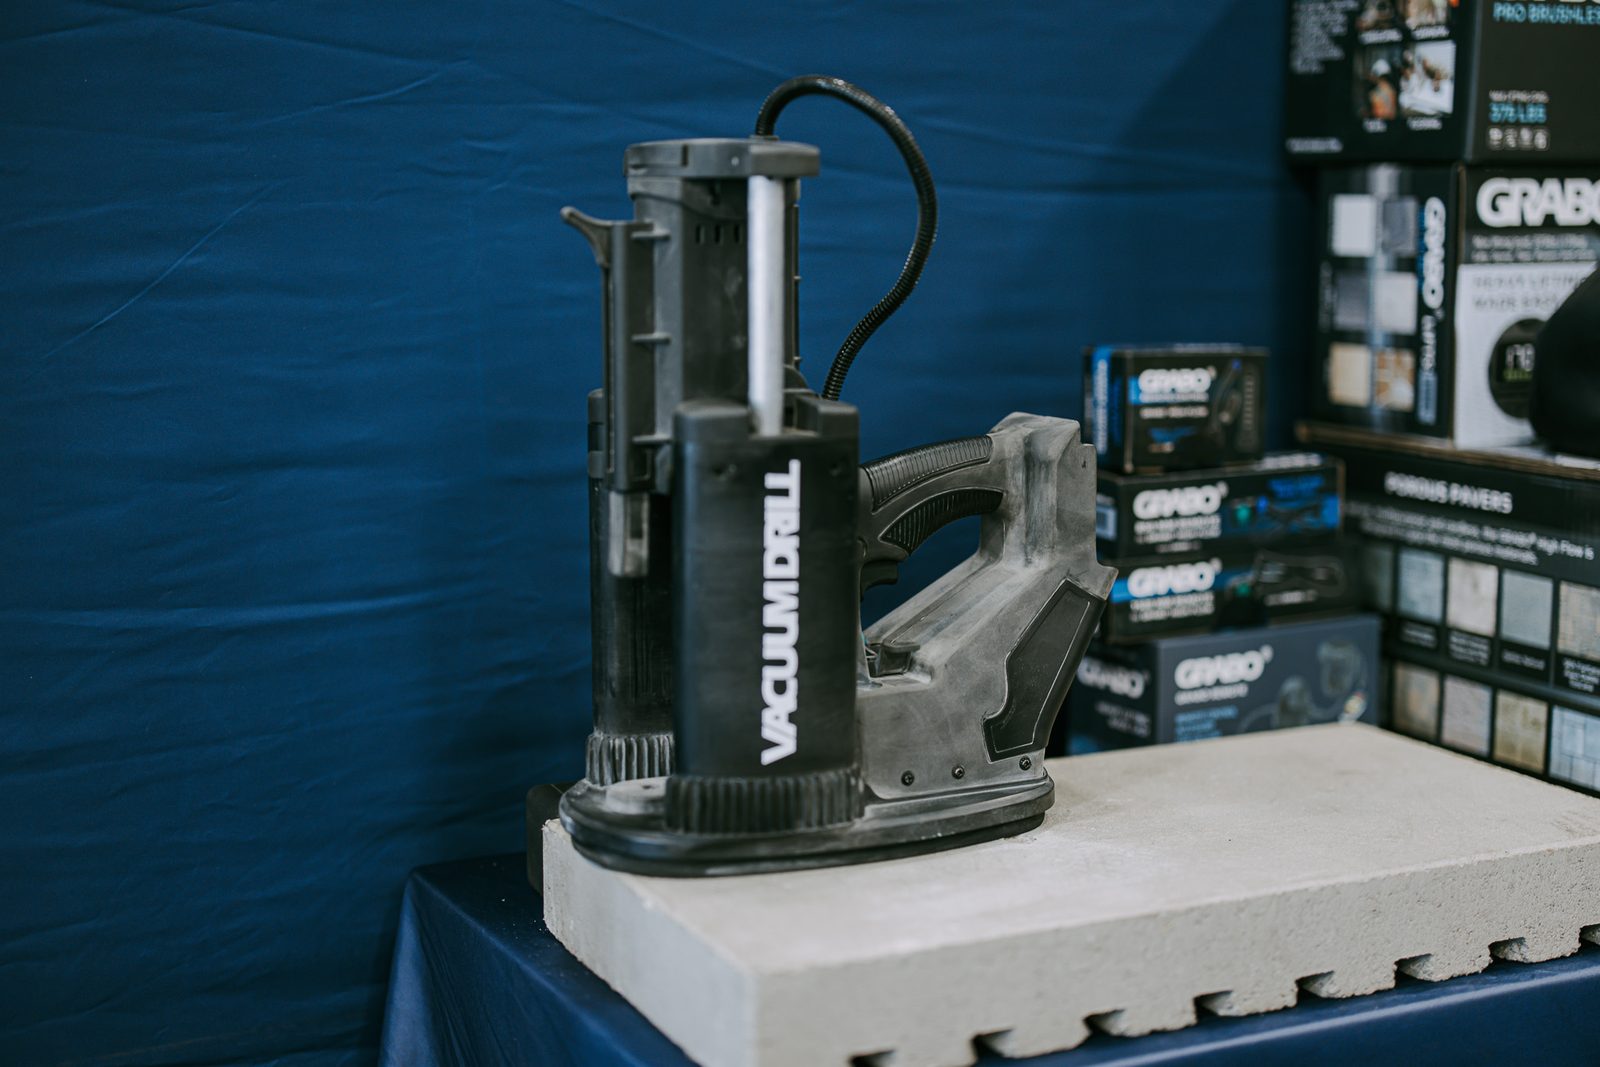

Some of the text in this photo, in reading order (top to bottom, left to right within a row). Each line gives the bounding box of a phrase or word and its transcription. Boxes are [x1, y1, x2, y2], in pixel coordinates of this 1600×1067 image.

[1493, 3, 1526, 22] PRO
[1476, 177, 1600, 227] GRAB
[1138, 368, 1211, 393] GRABO
[1133, 485, 1221, 520] GRABO
[1127, 561, 1215, 598] GRABO
[761, 459, 801, 766] VACUUM DRILL
[1174, 650, 1264, 690] GRABO
